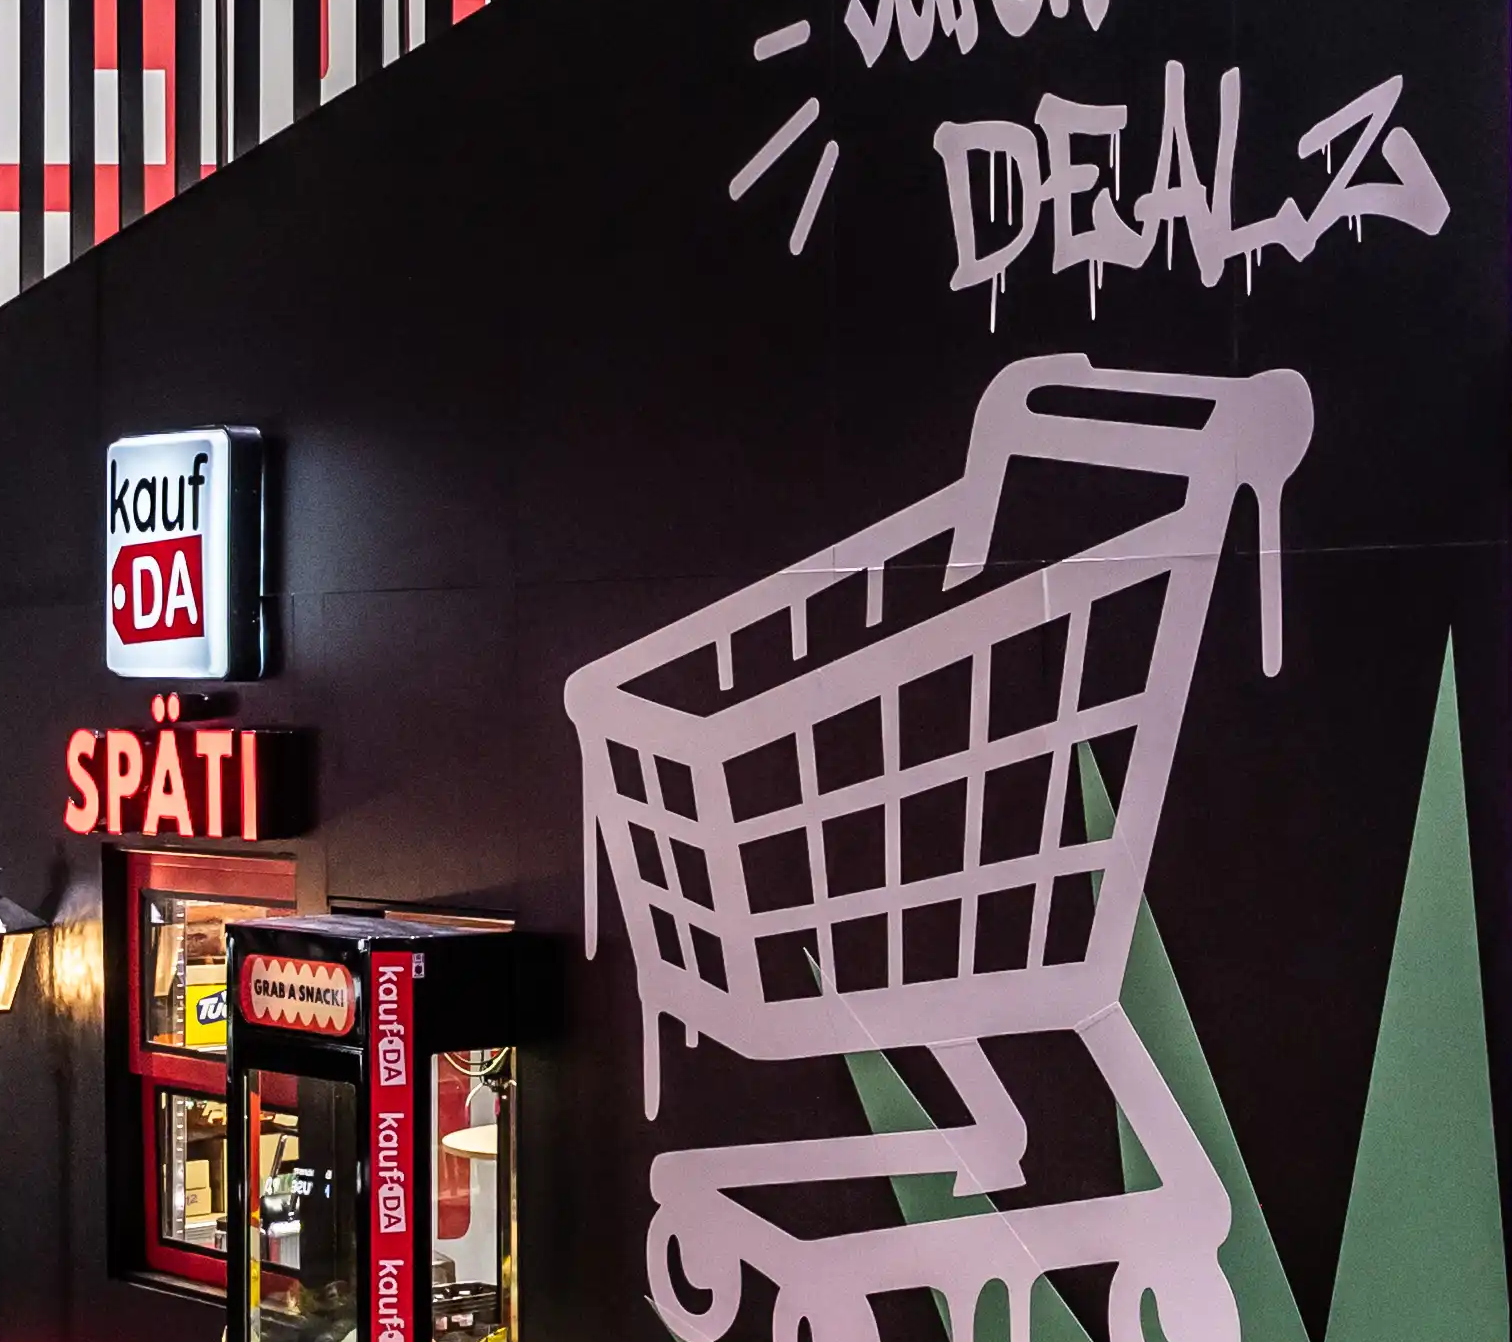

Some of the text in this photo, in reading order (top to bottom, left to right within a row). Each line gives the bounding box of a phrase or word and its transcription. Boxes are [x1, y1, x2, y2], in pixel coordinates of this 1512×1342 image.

[109, 452, 209, 535] kauf
[64, 691, 258, 841] SPÄTI
[254, 979, 345, 1007] GRAB A SNACK!
